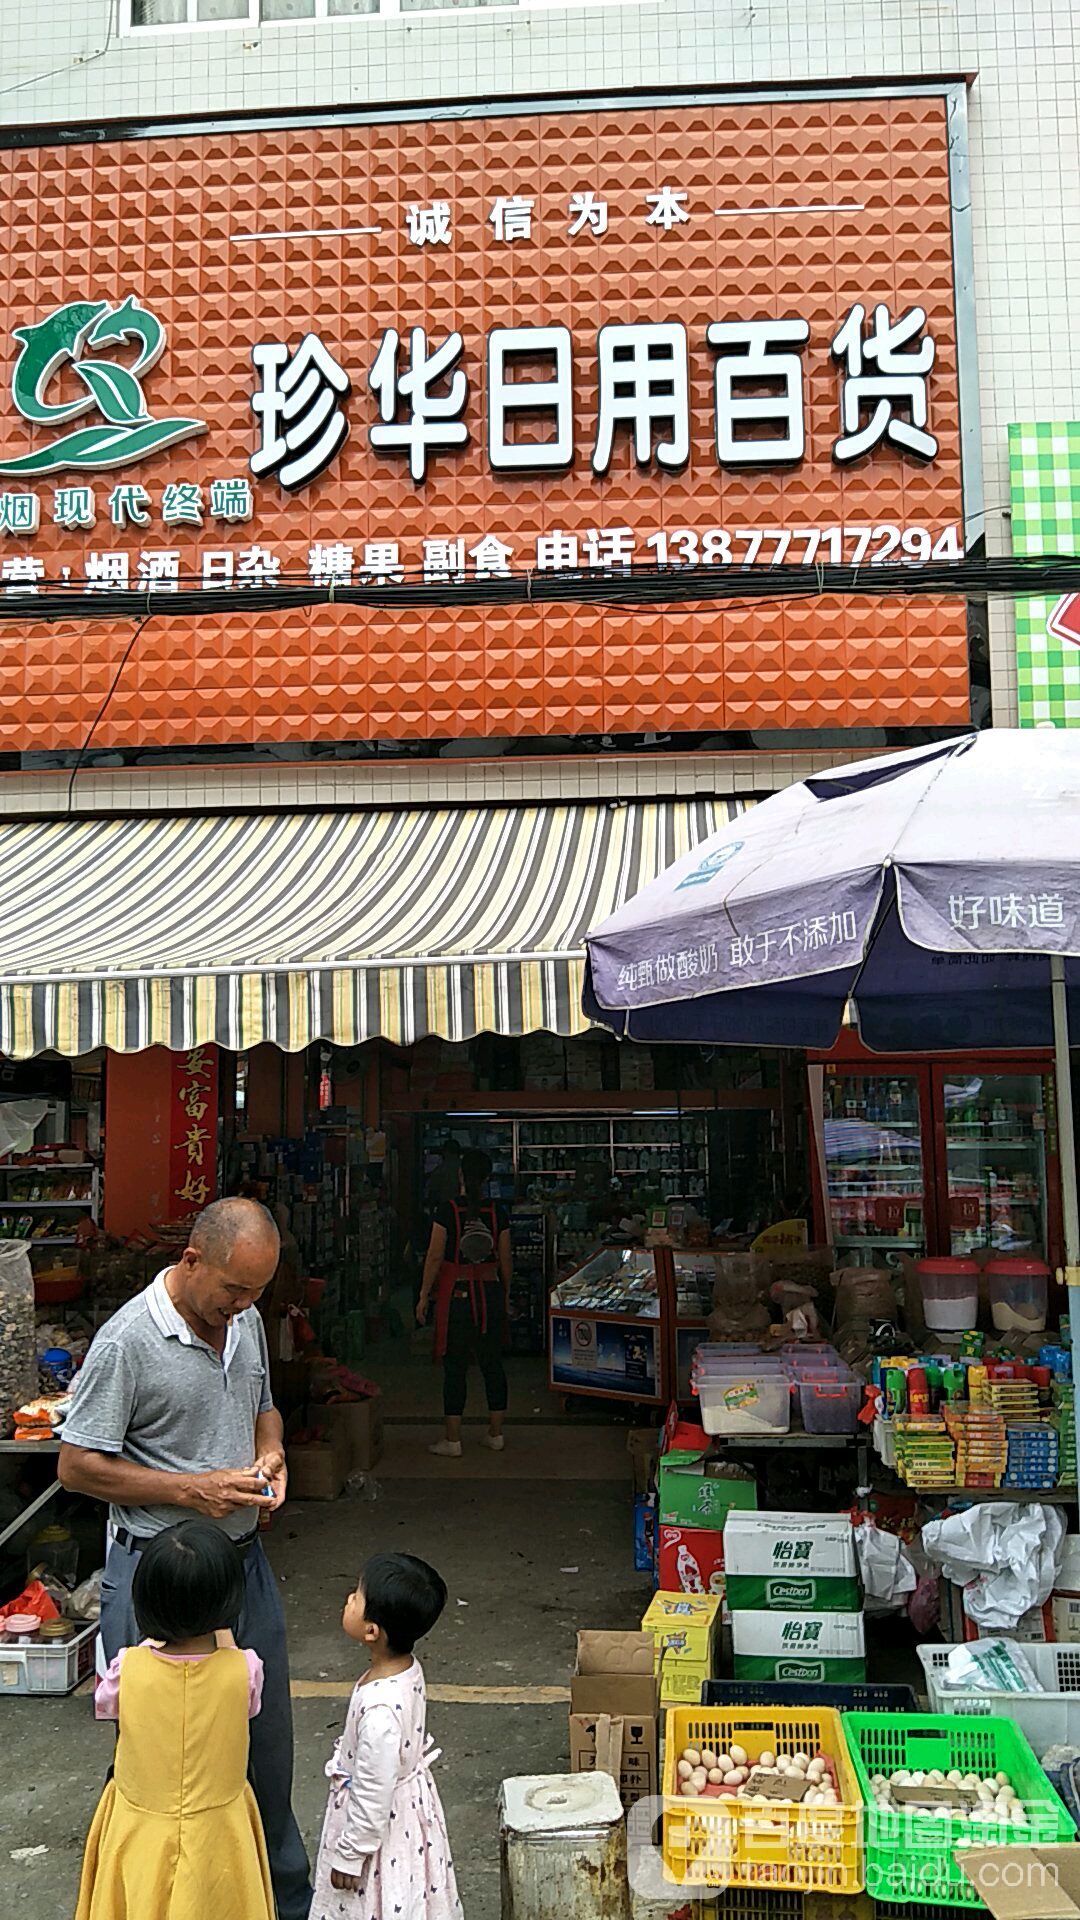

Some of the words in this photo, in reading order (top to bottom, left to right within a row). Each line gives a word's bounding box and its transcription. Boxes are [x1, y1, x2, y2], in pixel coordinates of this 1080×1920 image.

[406, 188, 690, 246] 诚信为本
[249, 301, 940, 490] 珍华日用百货
[308, 542, 405, 586] 糖果
[422, 534, 515, 585] 副食
[537, 526, 636, 579] 电话
[646, 524, 965, 572] 13877717294
[948, 893, 1066, 930] 好味道
[616, 943, 718, 991] 纯甄做酸奶
[729, 909, 858, 968] 敢于不添加
